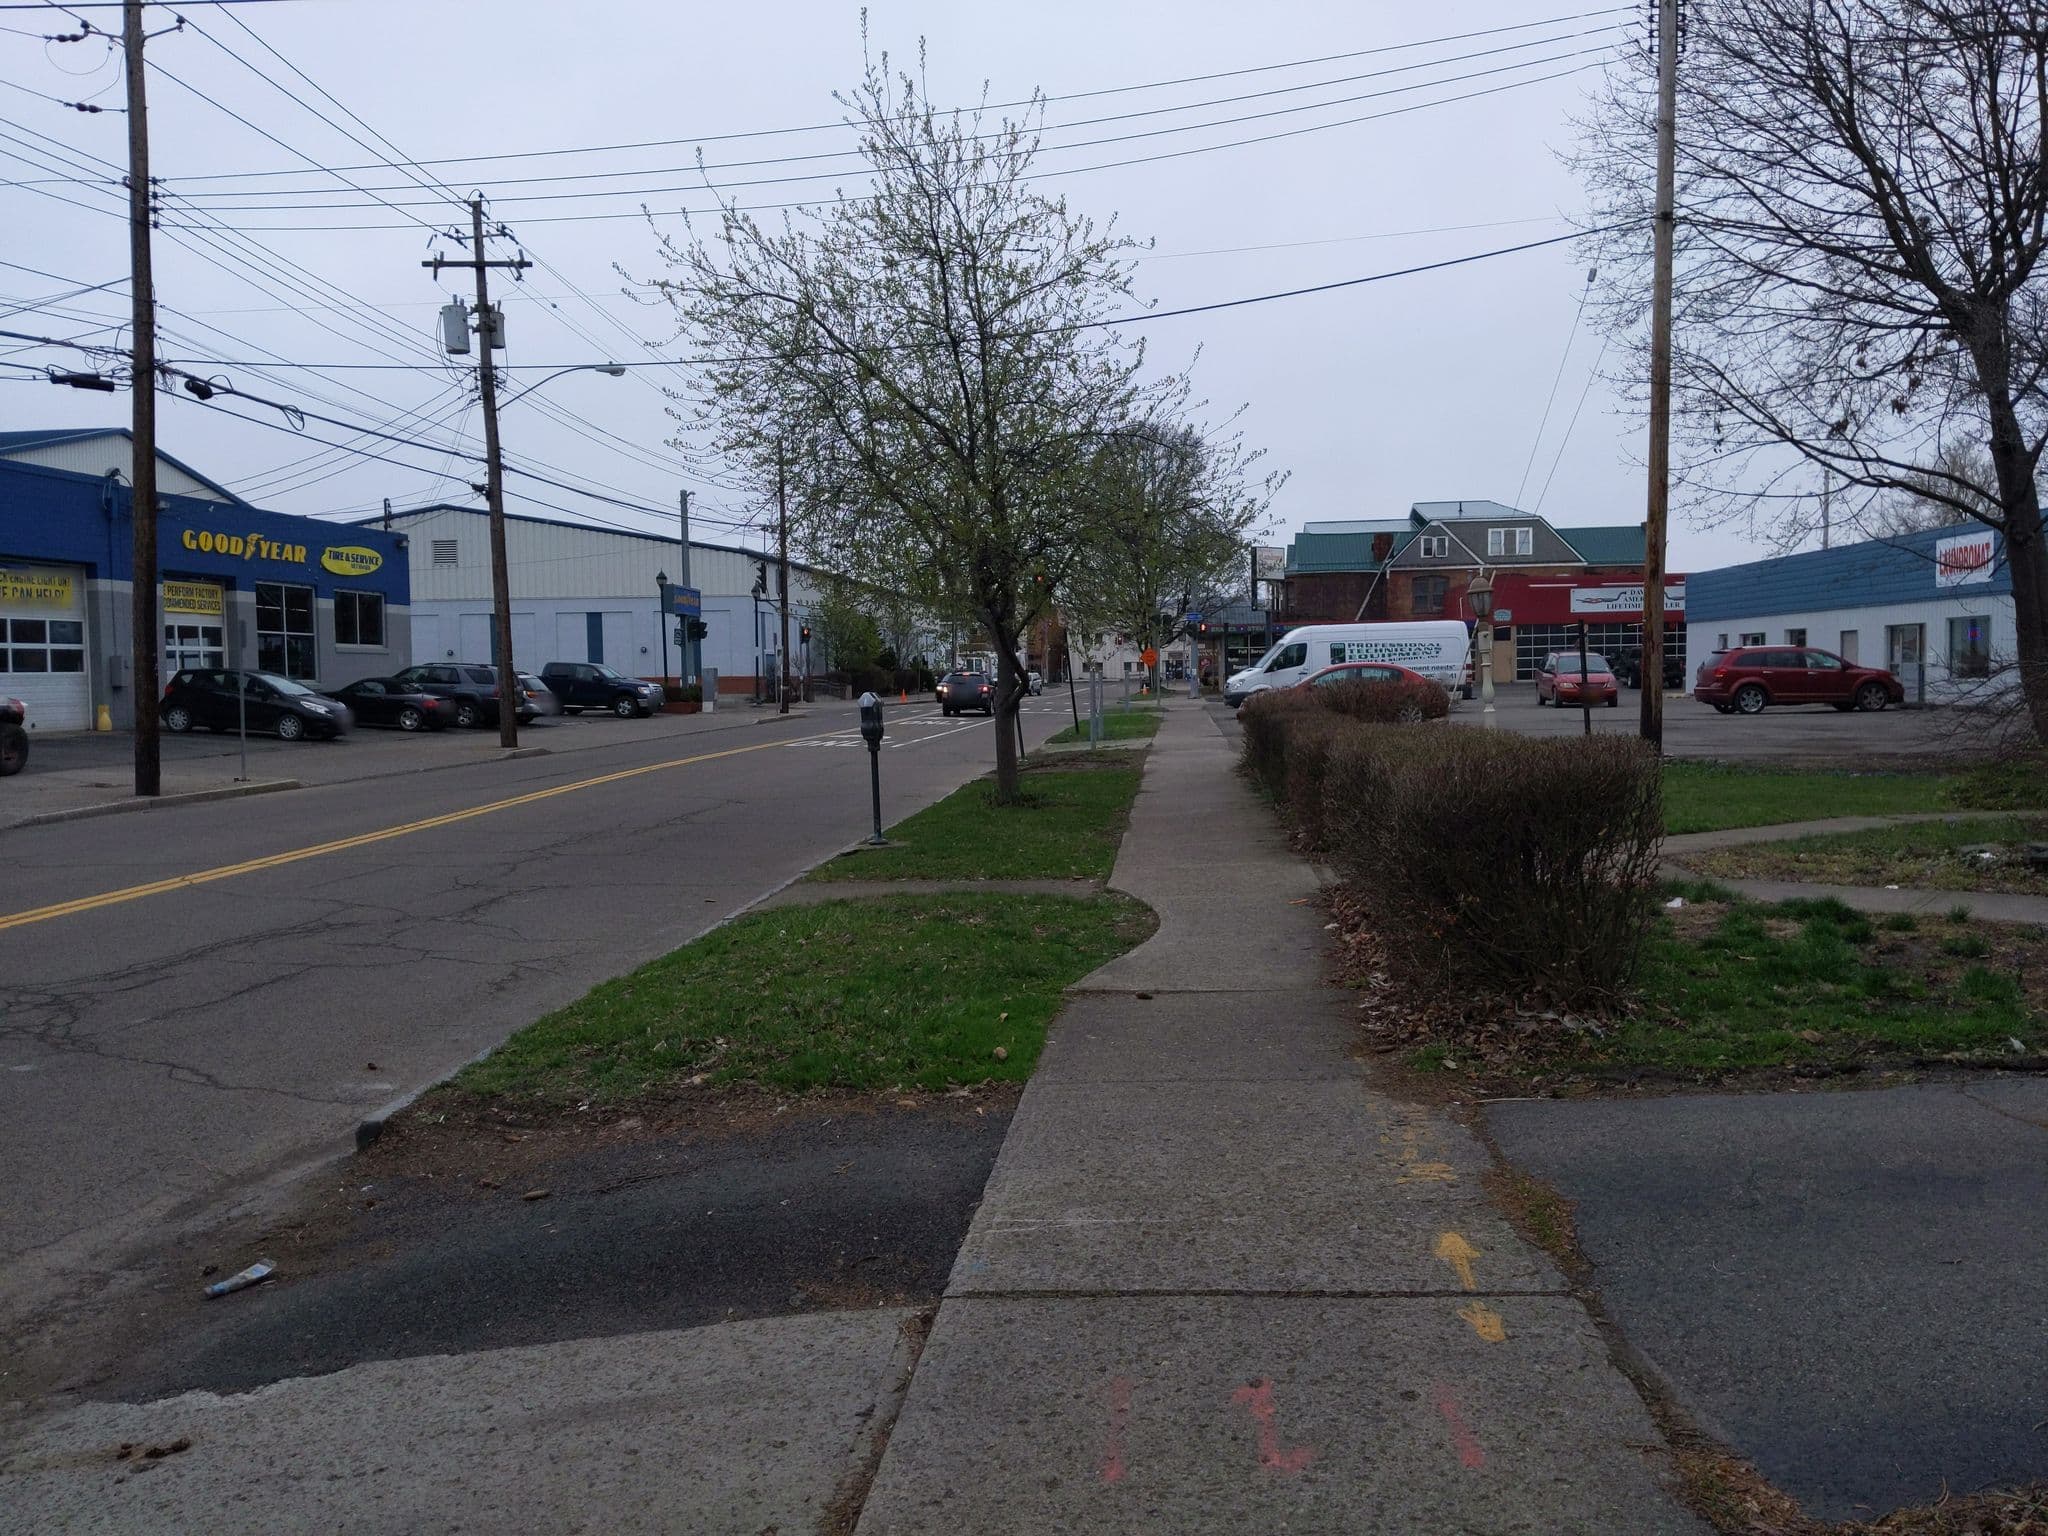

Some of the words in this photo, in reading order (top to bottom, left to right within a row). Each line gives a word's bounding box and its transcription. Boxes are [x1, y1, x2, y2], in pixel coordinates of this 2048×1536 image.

[328, 550, 344, 561] TIRE
[351, 553, 379, 566] SERVICE
[1939, 542, 1991, 577] LAUNDROMAT
[167, 585, 194, 597] PERFORM
[195, 587, 219, 600] FACTORY
[1348, 651, 1440, 659] EQUIPMENT
